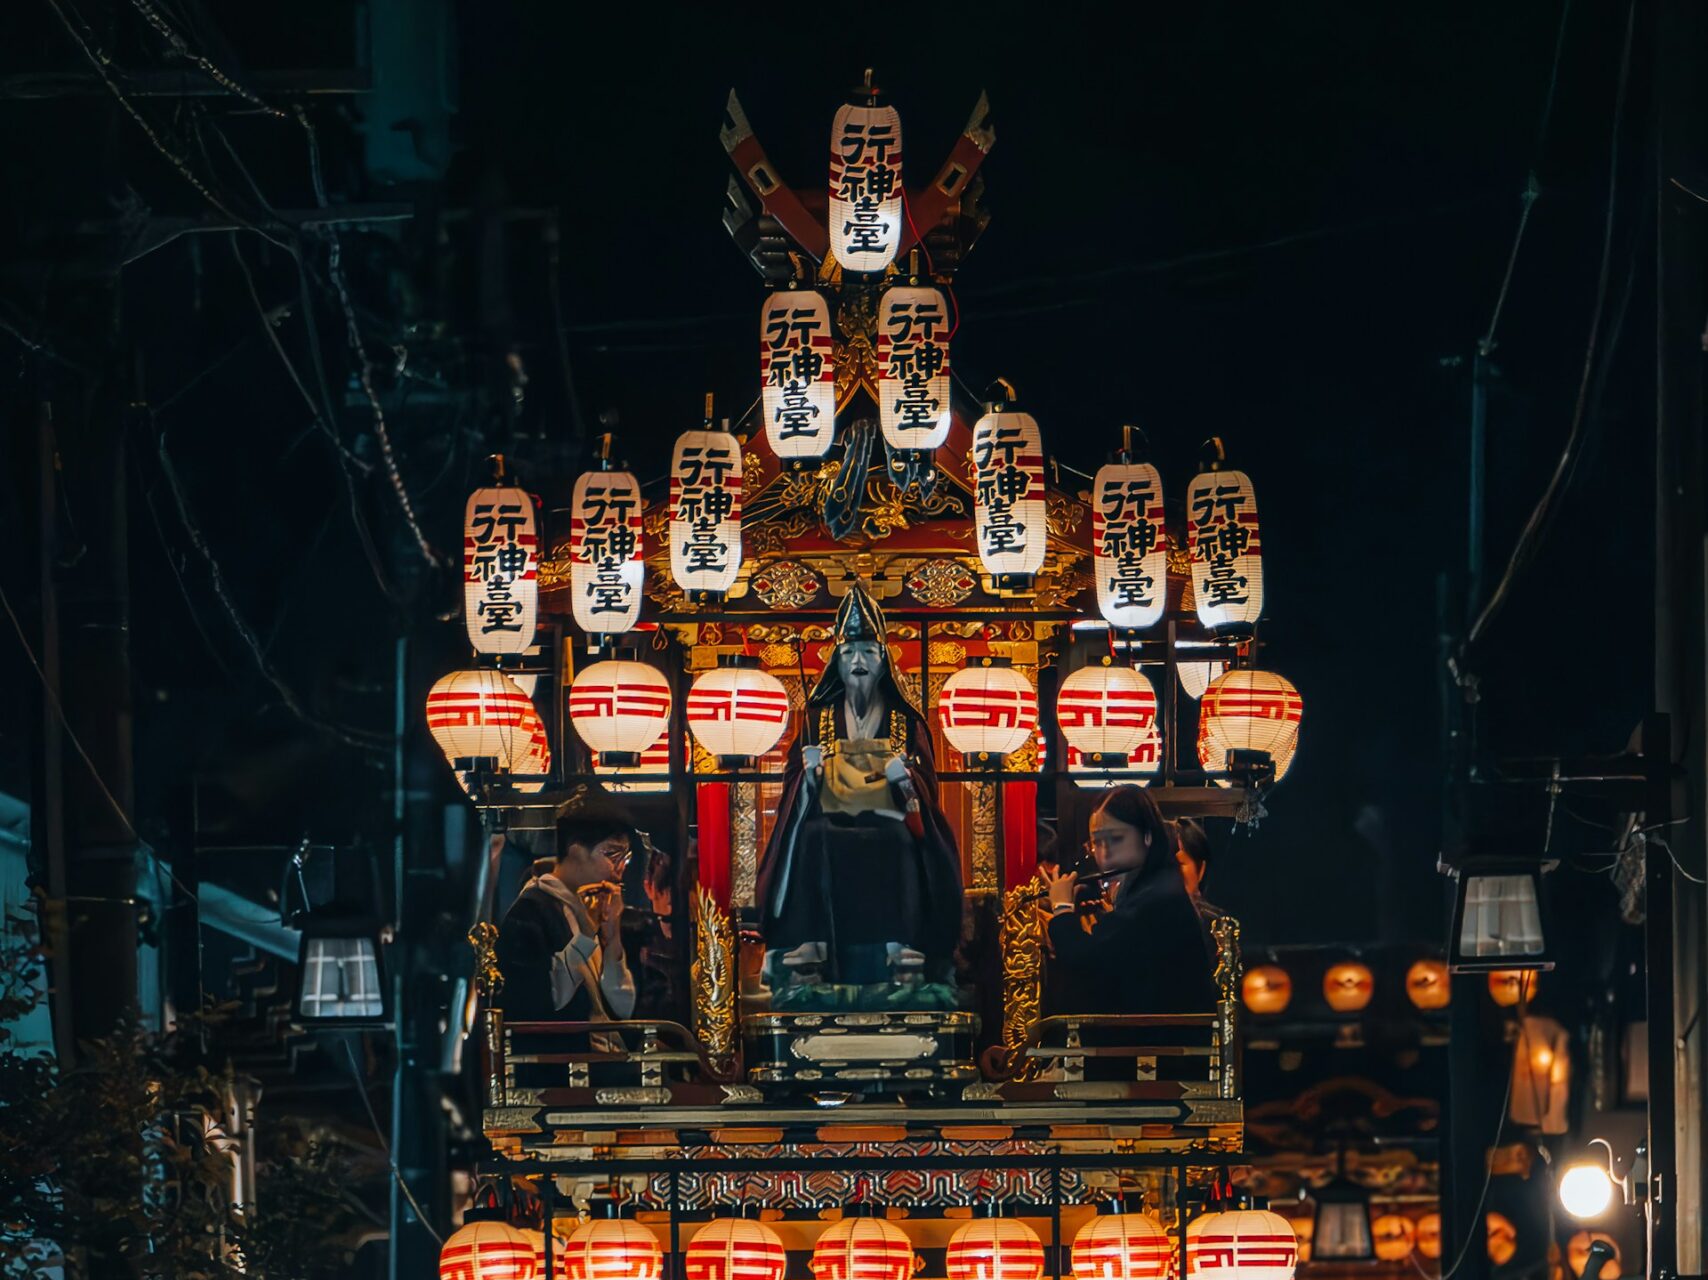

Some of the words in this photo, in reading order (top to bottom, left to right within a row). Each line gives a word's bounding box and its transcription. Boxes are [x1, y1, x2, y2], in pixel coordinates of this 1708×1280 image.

[842, 123, 896, 254] 行神臺
[768, 309, 822, 440] 行神臺
[887, 303, 944, 431] 行神臺
[580, 485, 635, 614] 行神臺
[677, 447, 732, 573] 行神臺
[974, 428, 1023, 555] 行神臺
[1102, 481, 1160, 608] 行神臺
[1193, 485, 1250, 608] 行神臺
[471, 504, 527, 634] 行神臺
